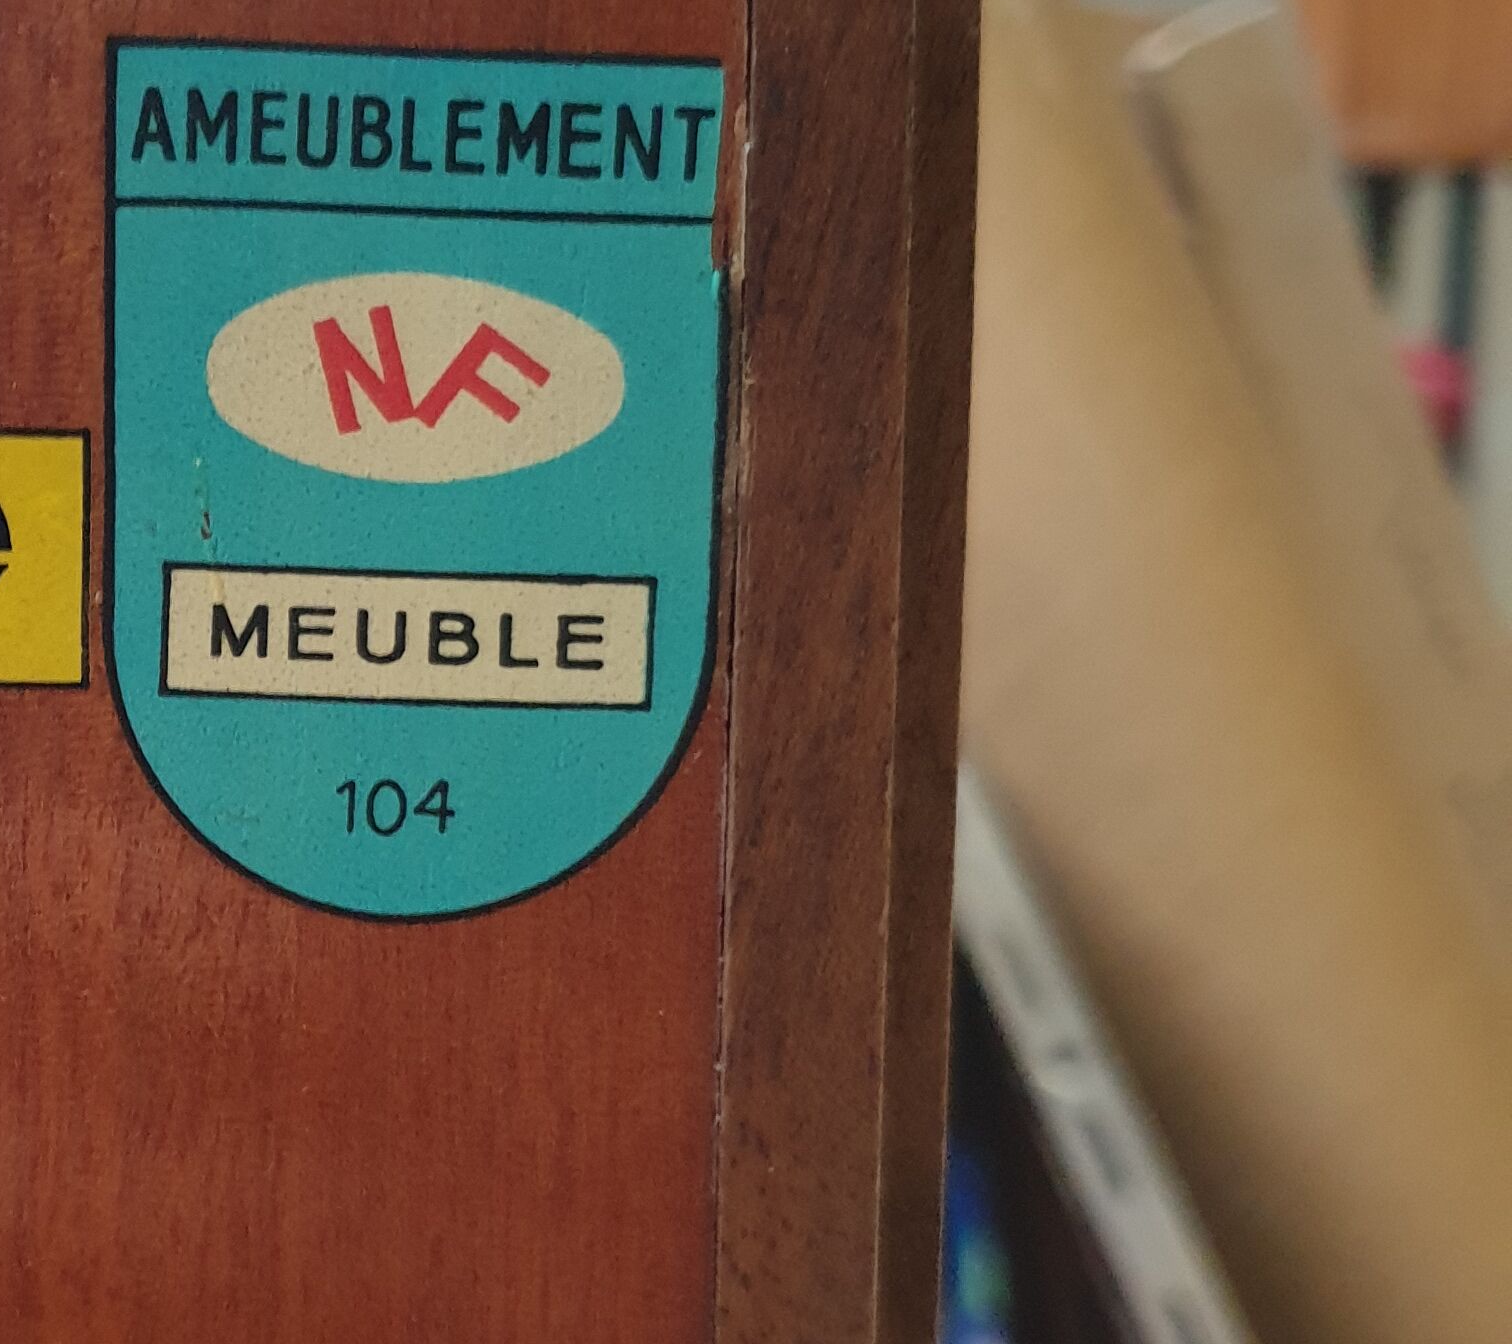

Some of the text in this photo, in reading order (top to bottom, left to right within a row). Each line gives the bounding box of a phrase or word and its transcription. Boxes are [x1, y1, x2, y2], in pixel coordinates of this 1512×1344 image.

[130, 86, 716, 183] AMEUBLEMENT
[312, 304, 552, 436] NF
[209, 603, 605, 671] MEUBLE
[335, 778, 456, 837] 104
